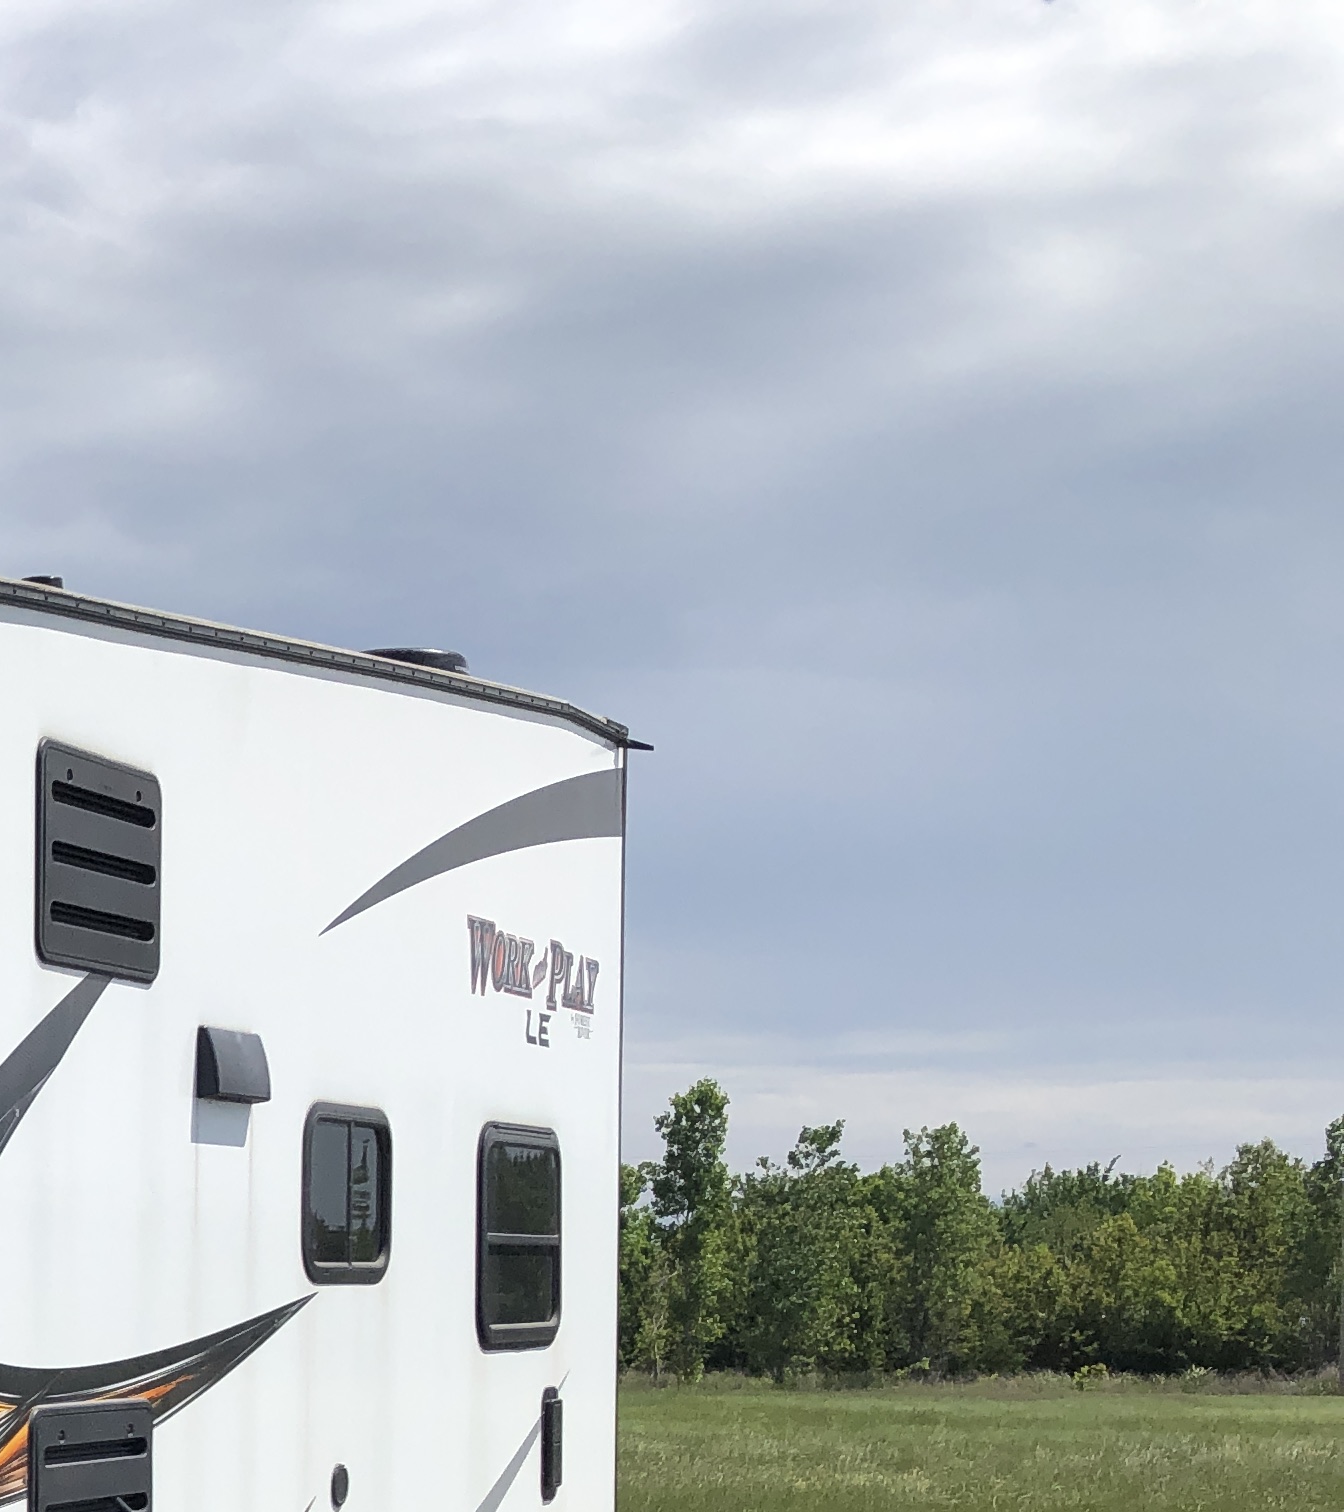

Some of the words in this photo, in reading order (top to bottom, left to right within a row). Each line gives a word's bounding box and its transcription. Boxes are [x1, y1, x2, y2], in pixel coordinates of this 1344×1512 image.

[467, 914, 534, 999] WORK
[546, 938, 599, 1015] PLAY
[525, 1009, 551, 1047] LE
